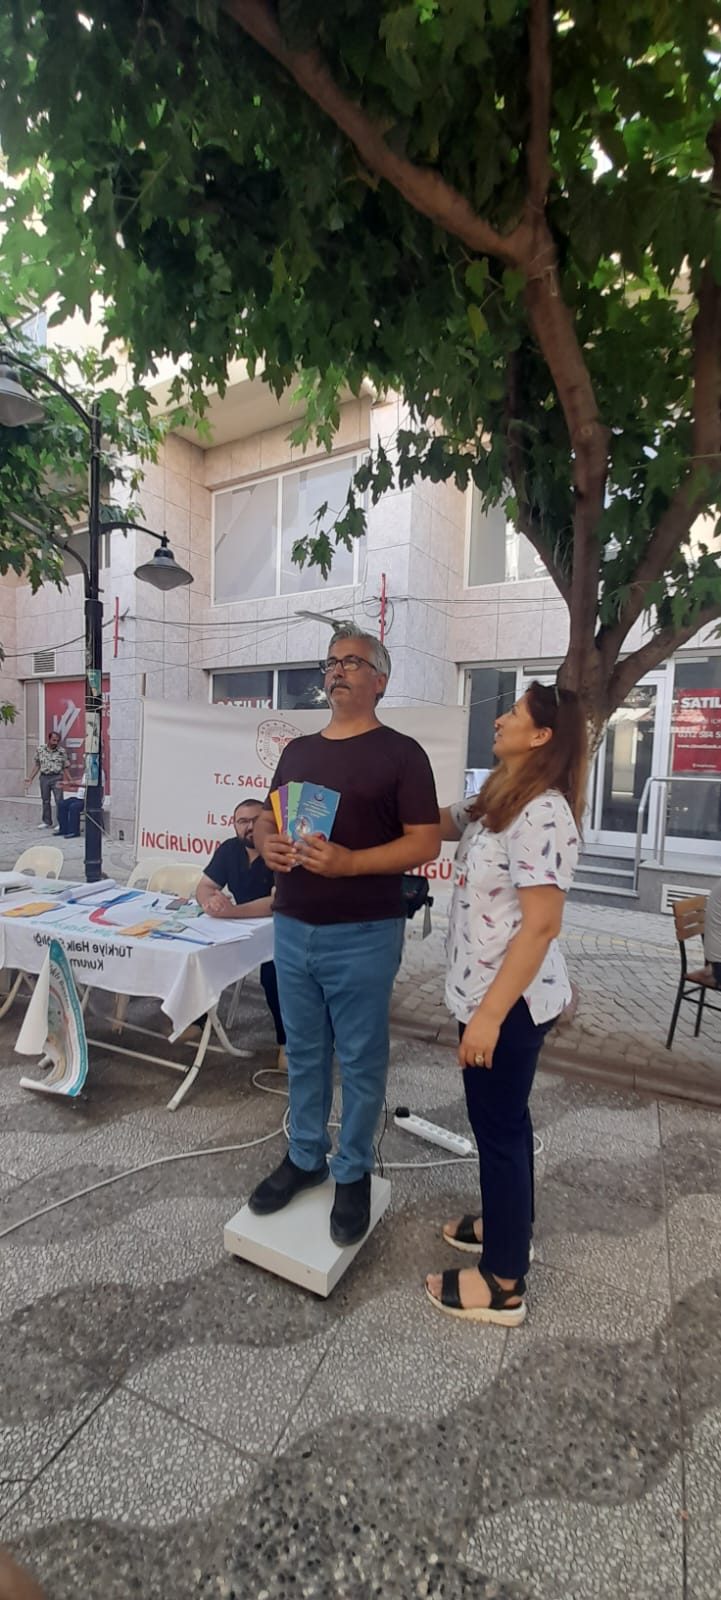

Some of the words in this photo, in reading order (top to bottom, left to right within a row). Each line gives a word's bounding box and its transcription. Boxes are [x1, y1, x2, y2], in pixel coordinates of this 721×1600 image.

[214, 773, 234, 786] T.C.
[238, 774, 270, 788] SAĞL
[207, 810, 217, 825] İL
